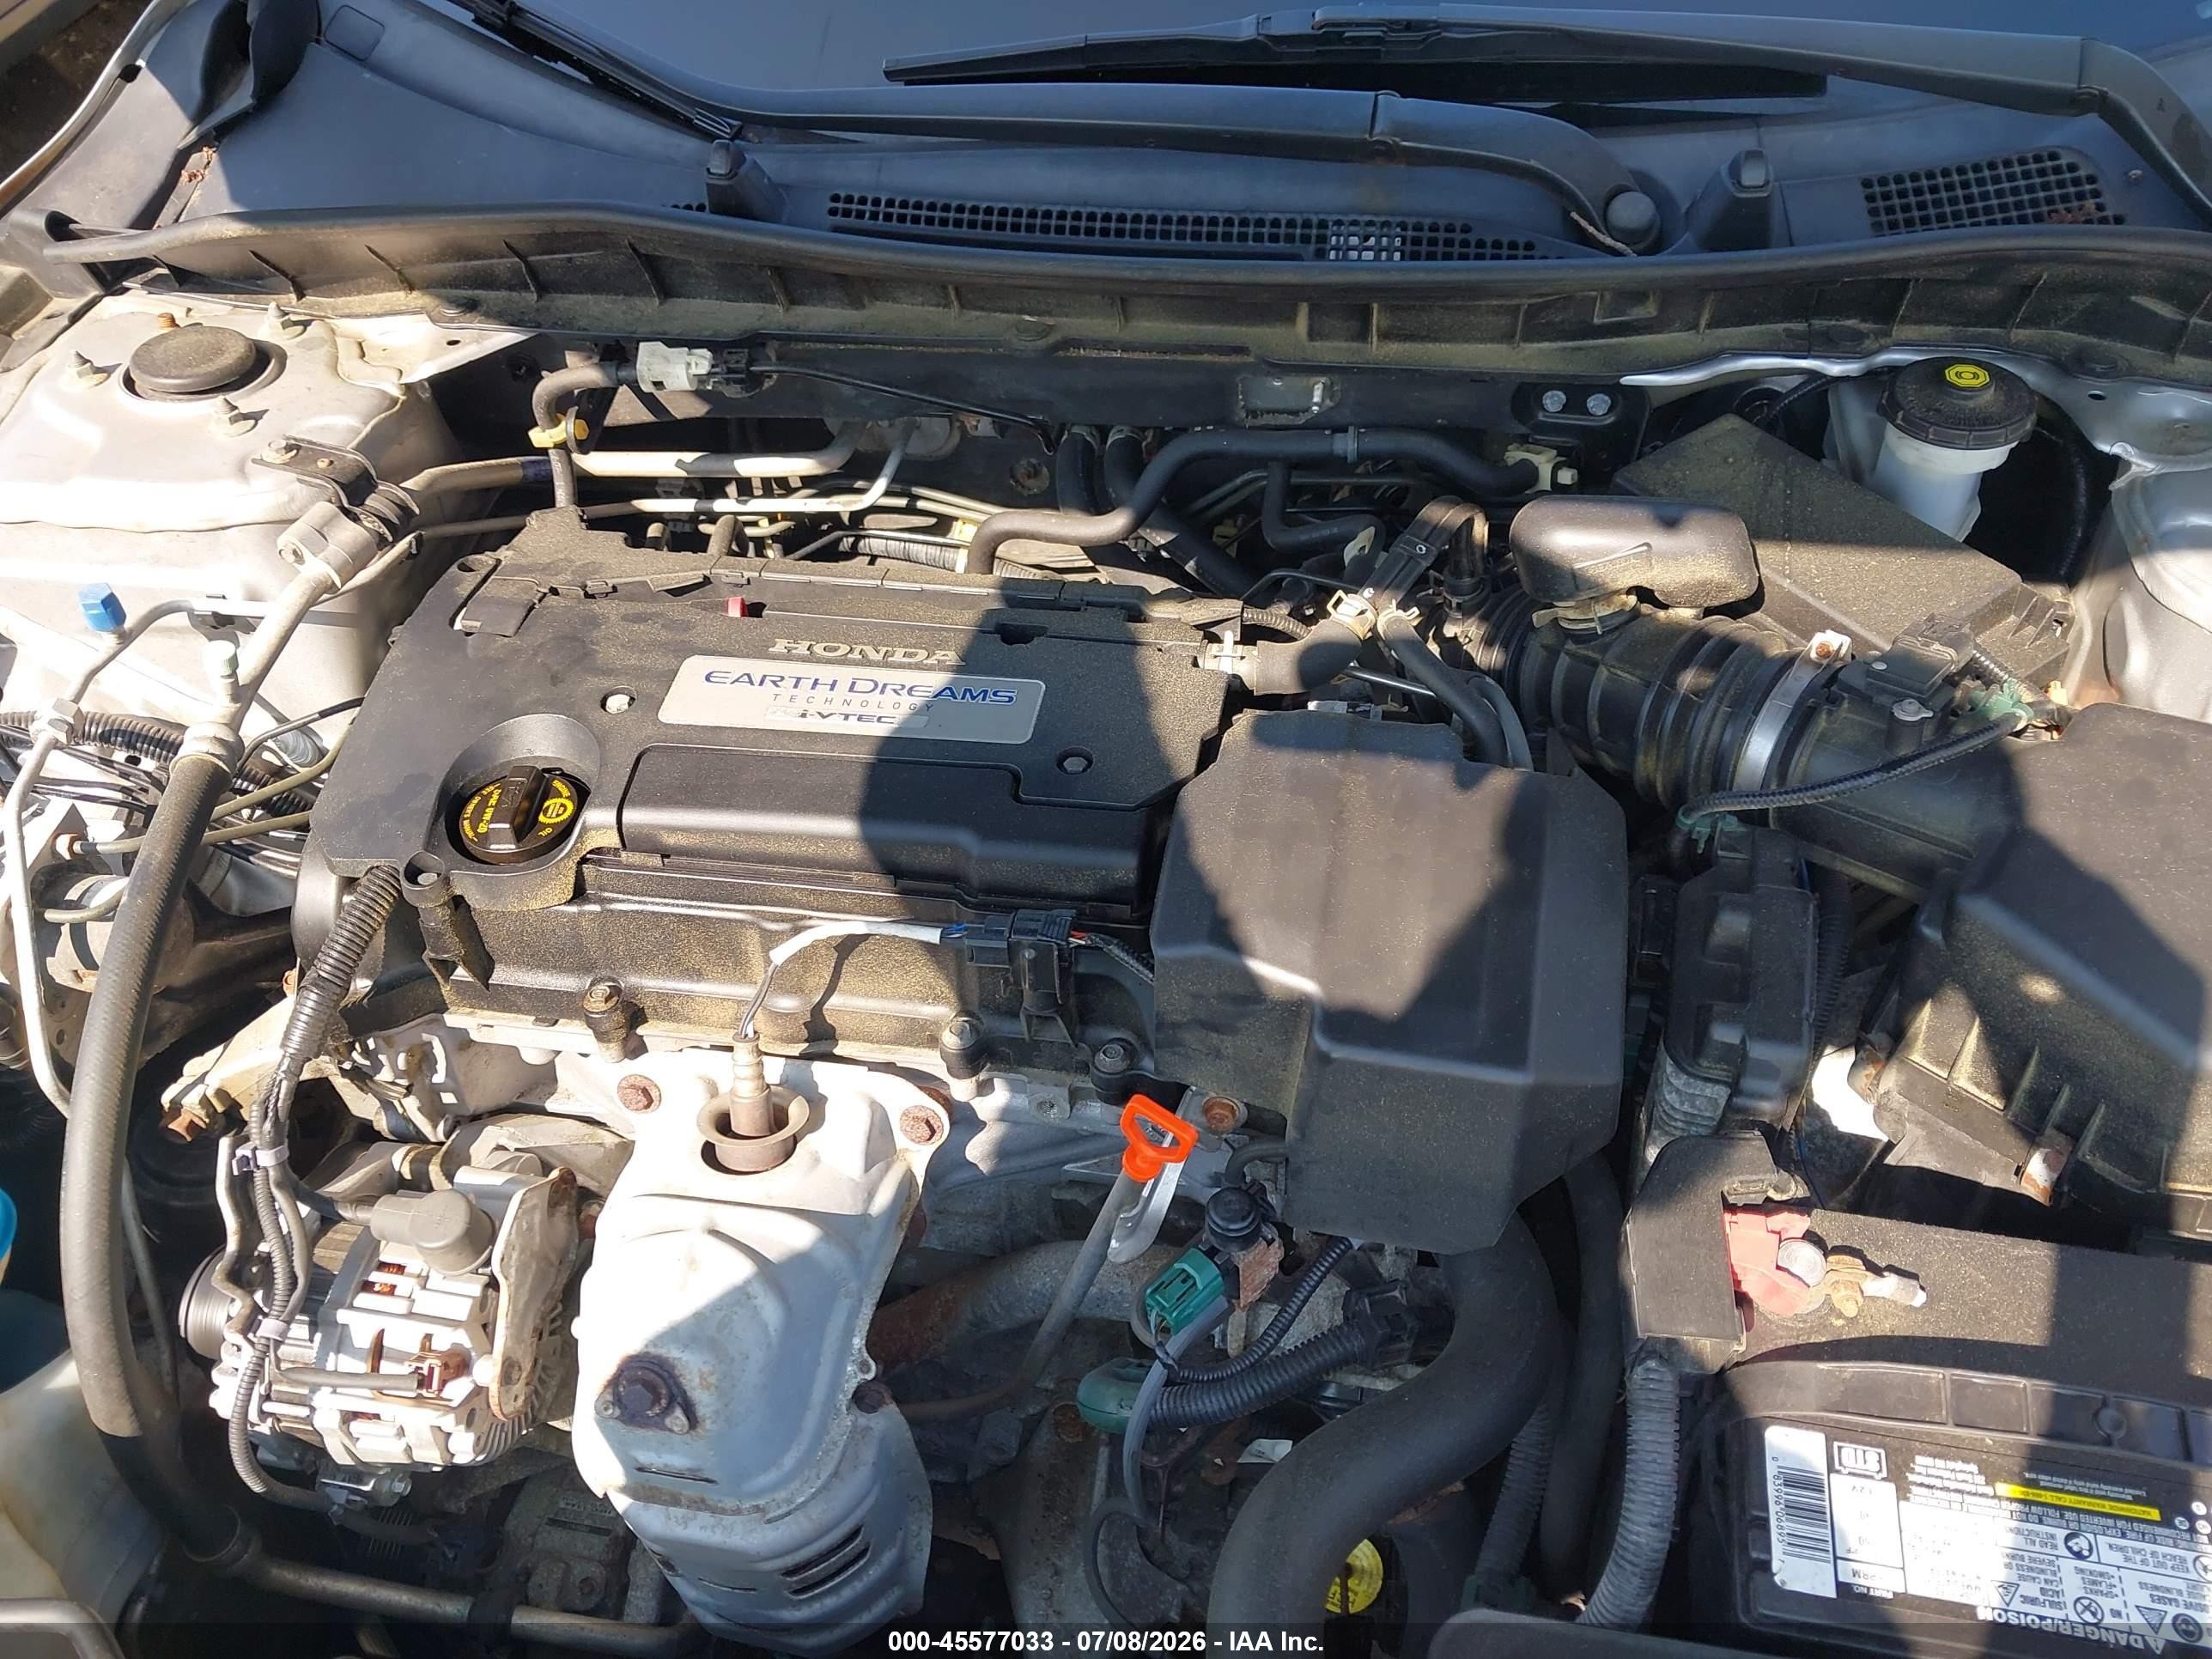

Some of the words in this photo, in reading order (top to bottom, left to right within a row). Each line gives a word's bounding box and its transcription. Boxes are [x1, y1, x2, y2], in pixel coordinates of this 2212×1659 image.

[769, 638, 966, 665] HONDA
[704, 671, 838, 691] EARTH
[848, 678, 1018, 705] DREAMS
[773, 693, 933, 711] TECHNOLOGY
[798, 709, 896, 725] i-VTEC
[552, 779, 571, 798] ENGINE
[538, 827, 553, 836] OIL
[1841, 1447, 1881, 1472] STD
[1772, 1474, 1784, 1507] 83996
[1775, 1510, 1786, 1544] 06895
[2023, 1538, 2036, 1547] ALL
[2039, 1540, 2058, 1550] READ
[2016, 1573, 2041, 1583] CAUSE
[2044, 1577, 2059, 1587] CAN
[2039, 1587, 2060, 1598] ACID
[2019, 1595, 2063, 1610] SULFURIC
[2109, 1608, 2123, 1620] NO
[1976, 1606, 2145, 1649] DANGER/POISON
